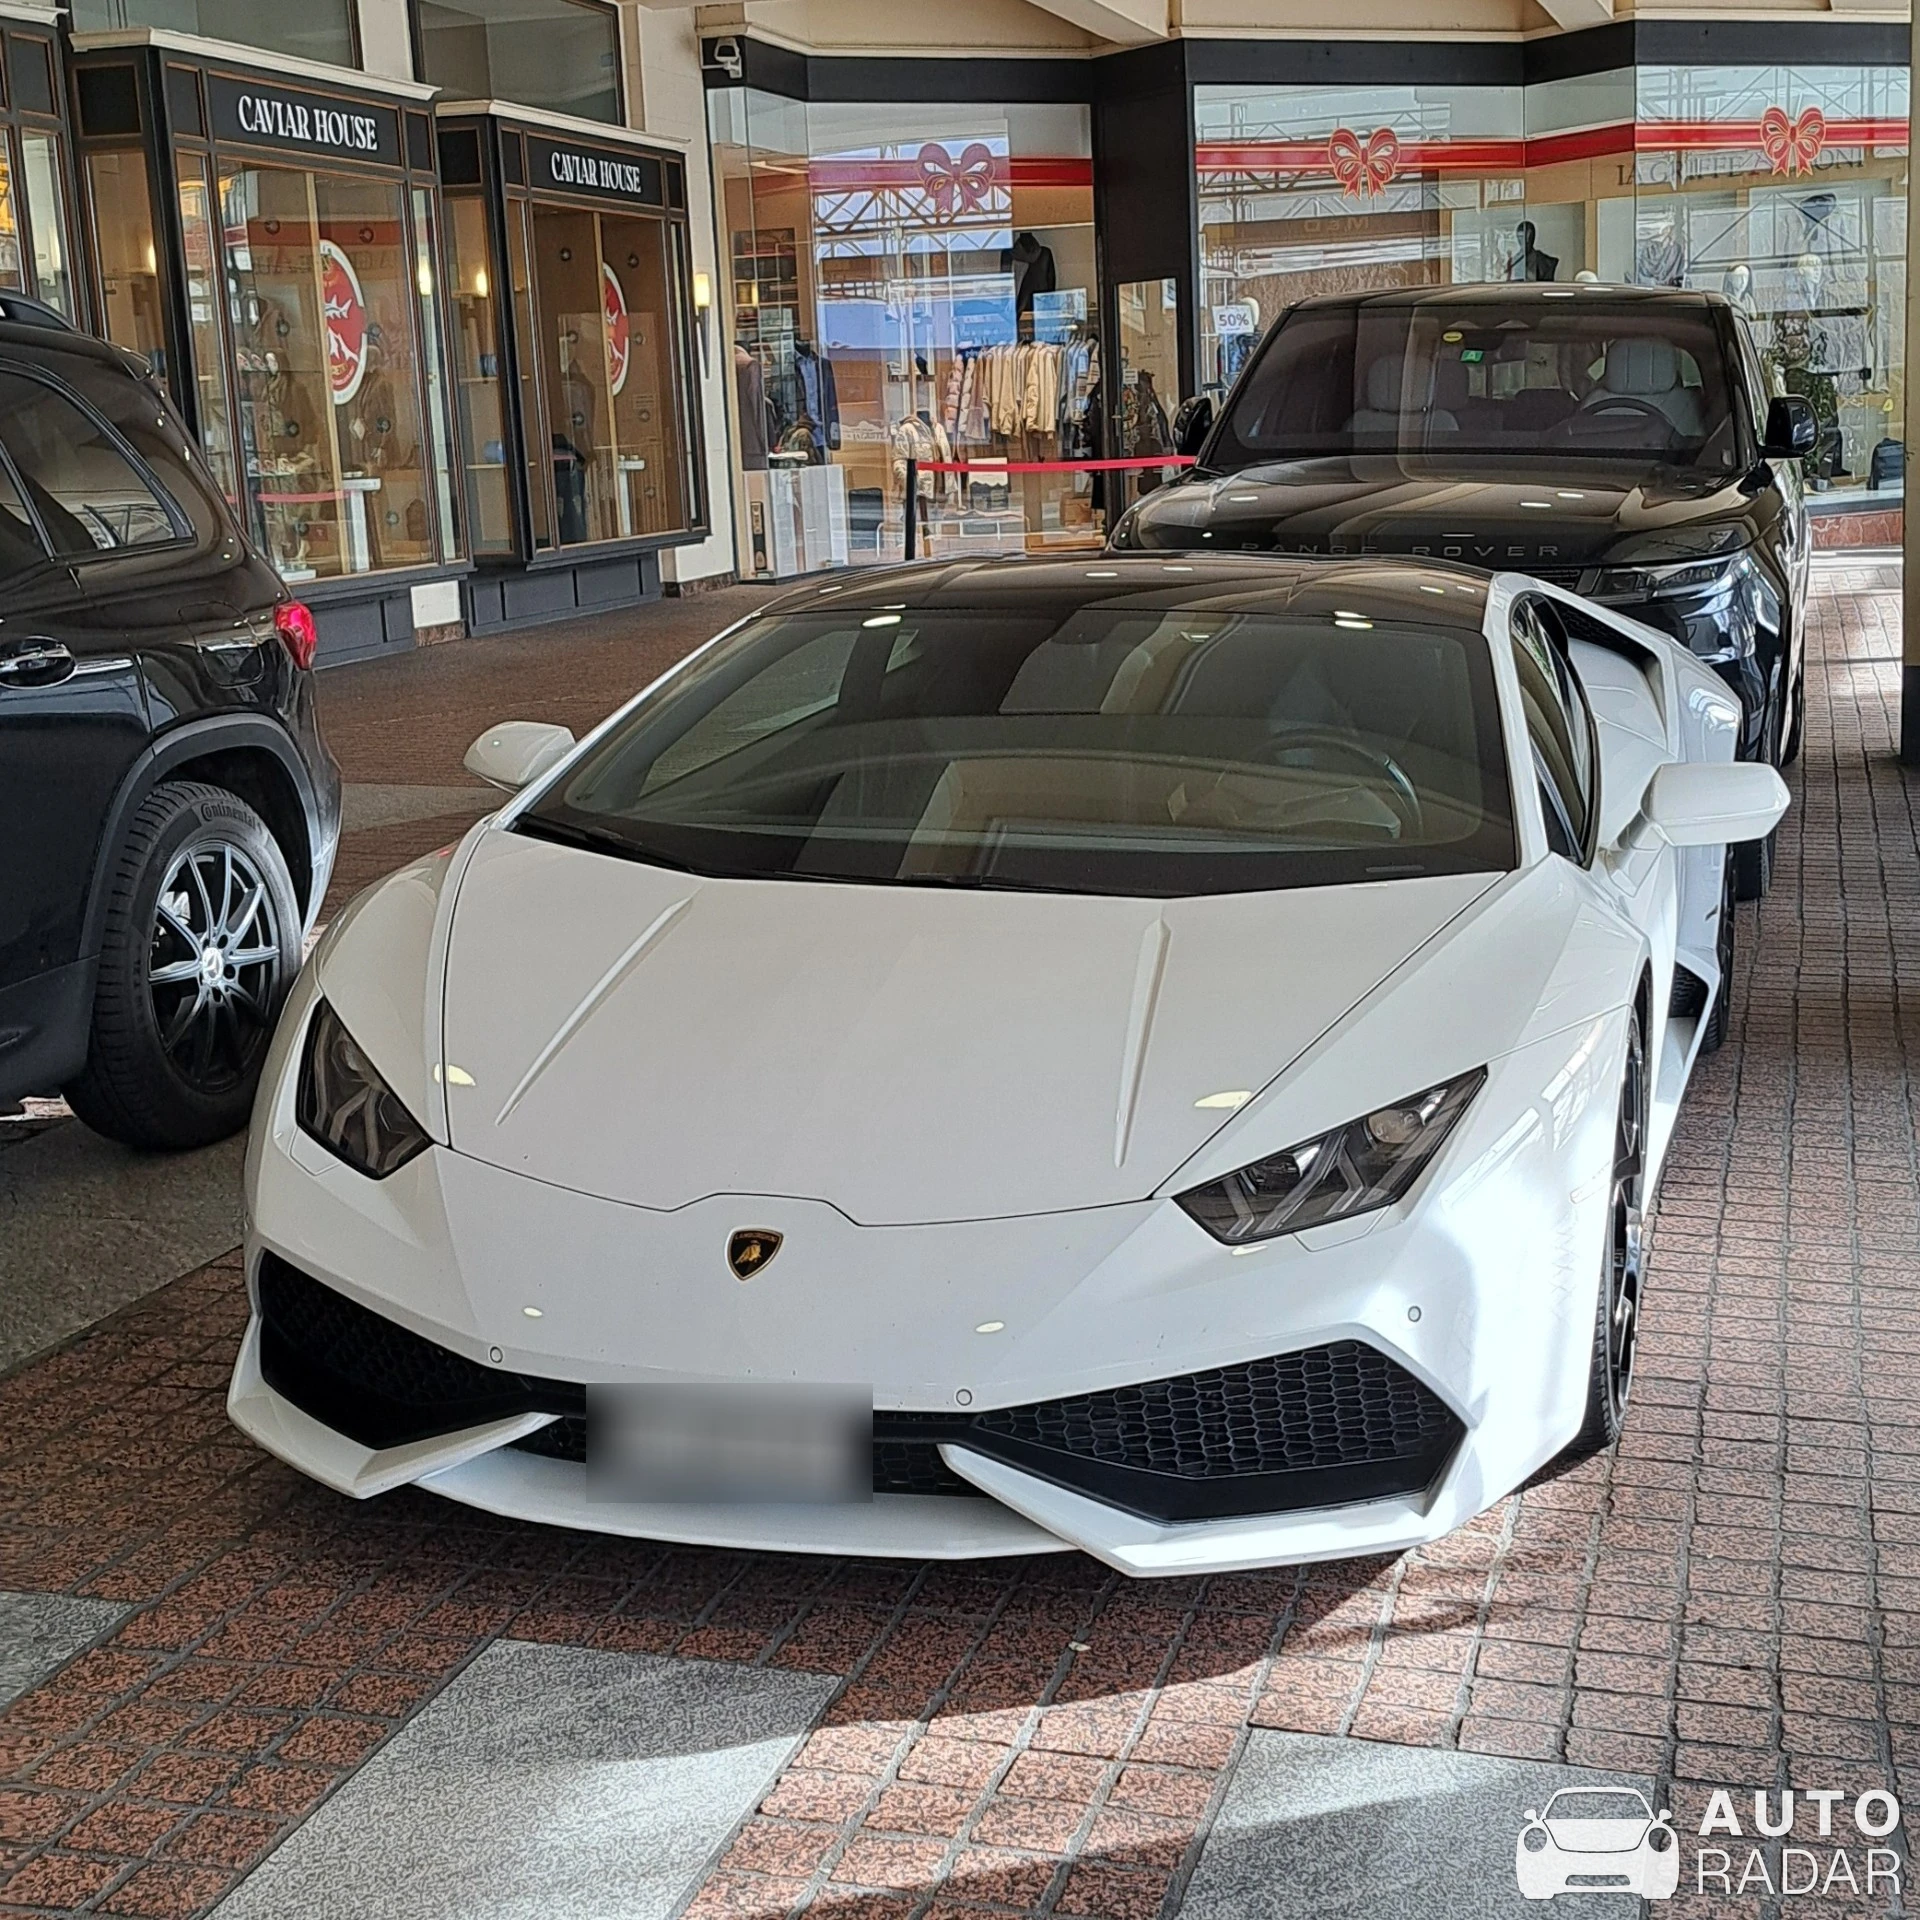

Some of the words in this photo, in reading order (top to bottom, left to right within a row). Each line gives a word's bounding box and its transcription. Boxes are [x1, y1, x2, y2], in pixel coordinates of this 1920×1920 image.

[238, 95, 312, 140] CAVIAR
[313, 108, 377, 150] HOUSE
[551, 152, 598, 186] CAVIAR
[599, 160, 641, 193] HOUSE
[1219, 313, 1249, 326] 50%
[1412, 545, 1558, 557] ROVER
